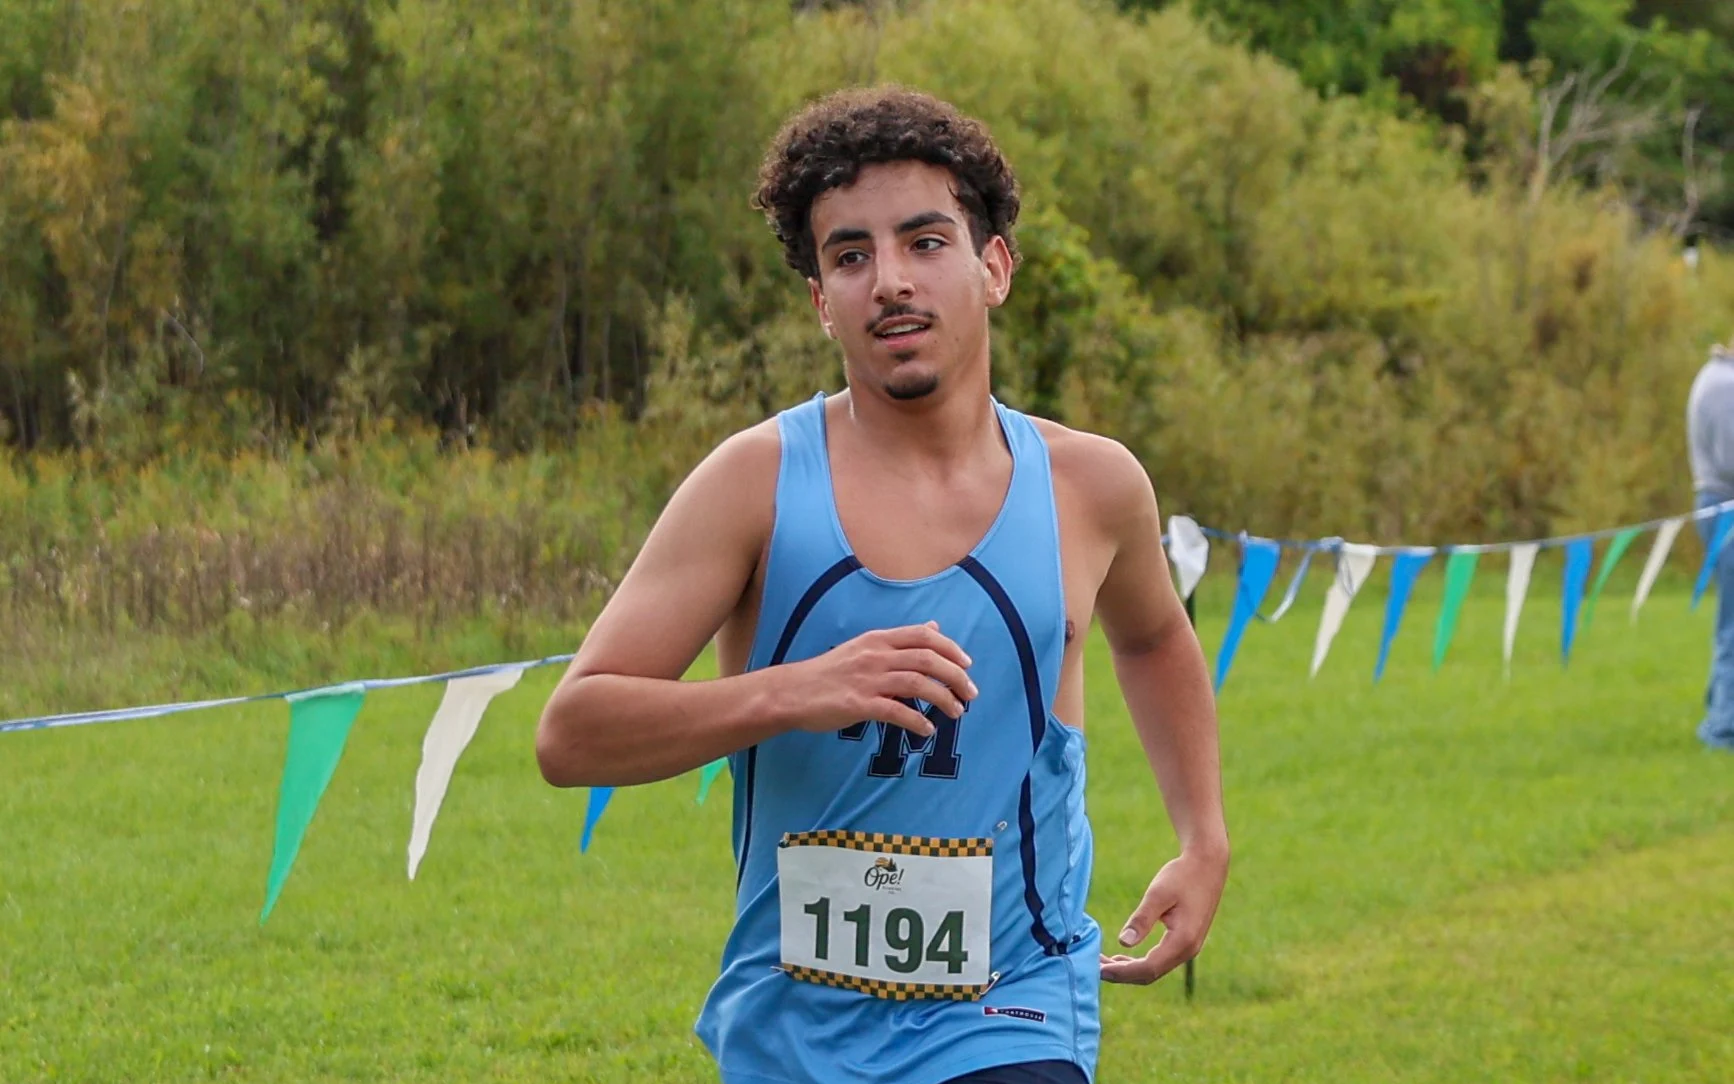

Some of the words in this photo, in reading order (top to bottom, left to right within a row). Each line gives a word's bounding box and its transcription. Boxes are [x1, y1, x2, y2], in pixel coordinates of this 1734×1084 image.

[837, 675, 970, 780] M
[864, 866, 904, 891] Ope!
[804, 896, 968, 974] 1194
